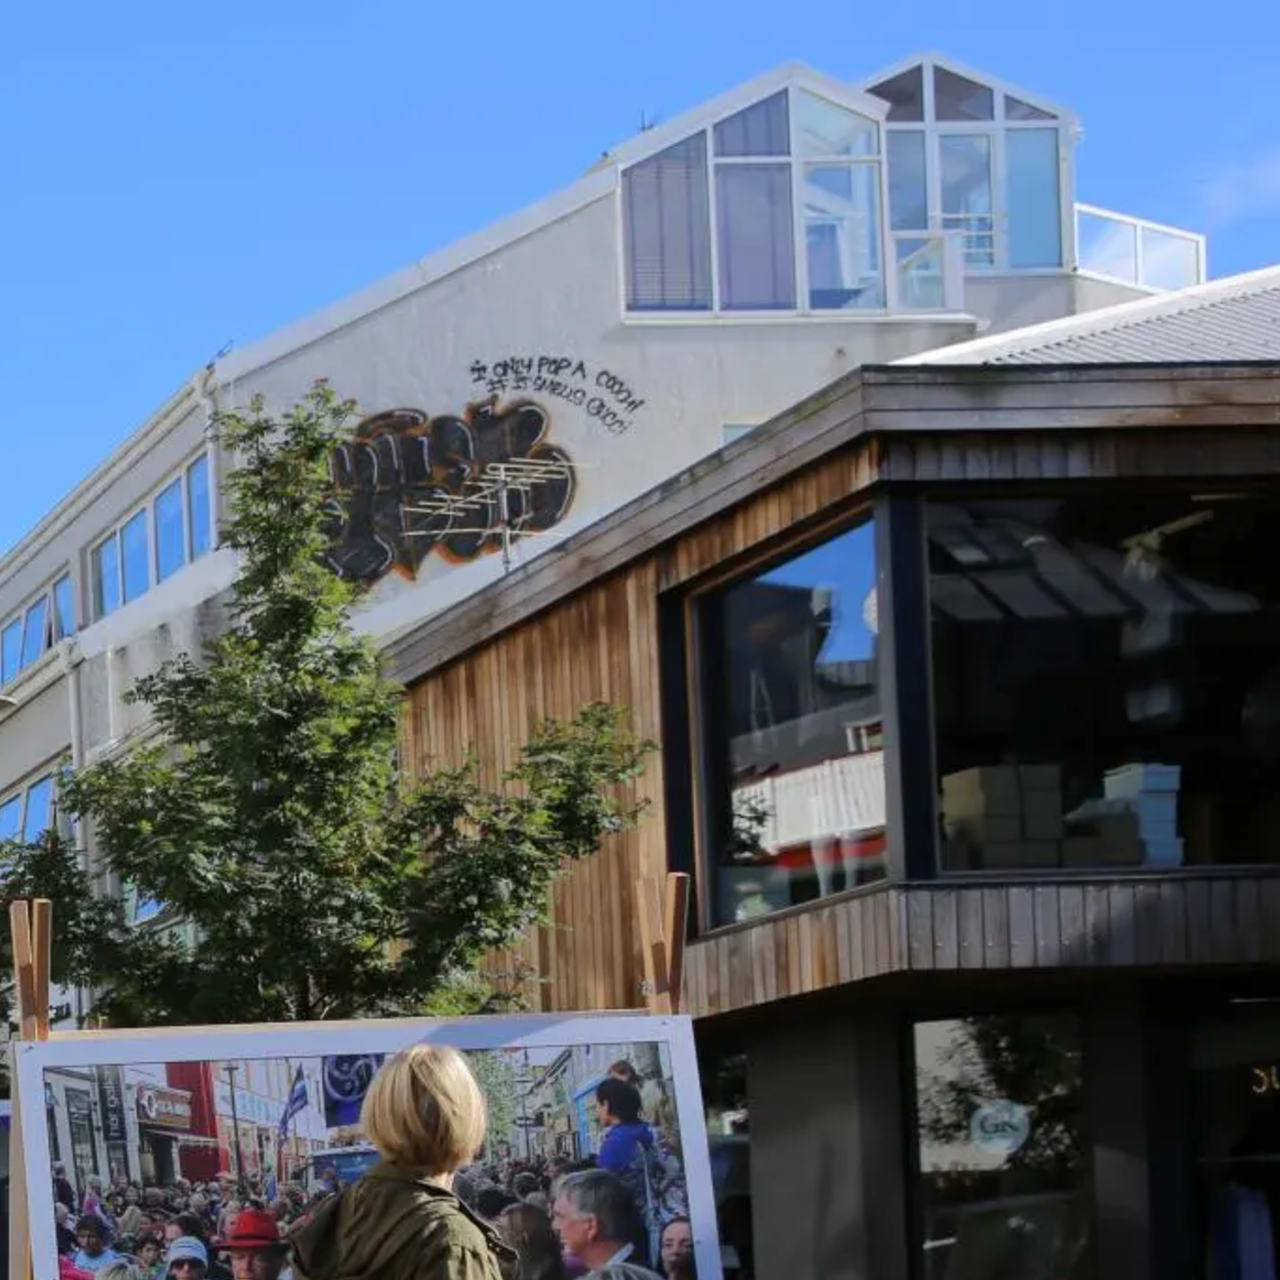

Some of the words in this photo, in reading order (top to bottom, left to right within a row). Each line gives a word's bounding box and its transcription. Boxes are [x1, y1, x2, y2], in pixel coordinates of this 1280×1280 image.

[492, 357, 532, 377] ONLY
[537, 357, 570, 376] POP
[571, 360, 587, 379] A
